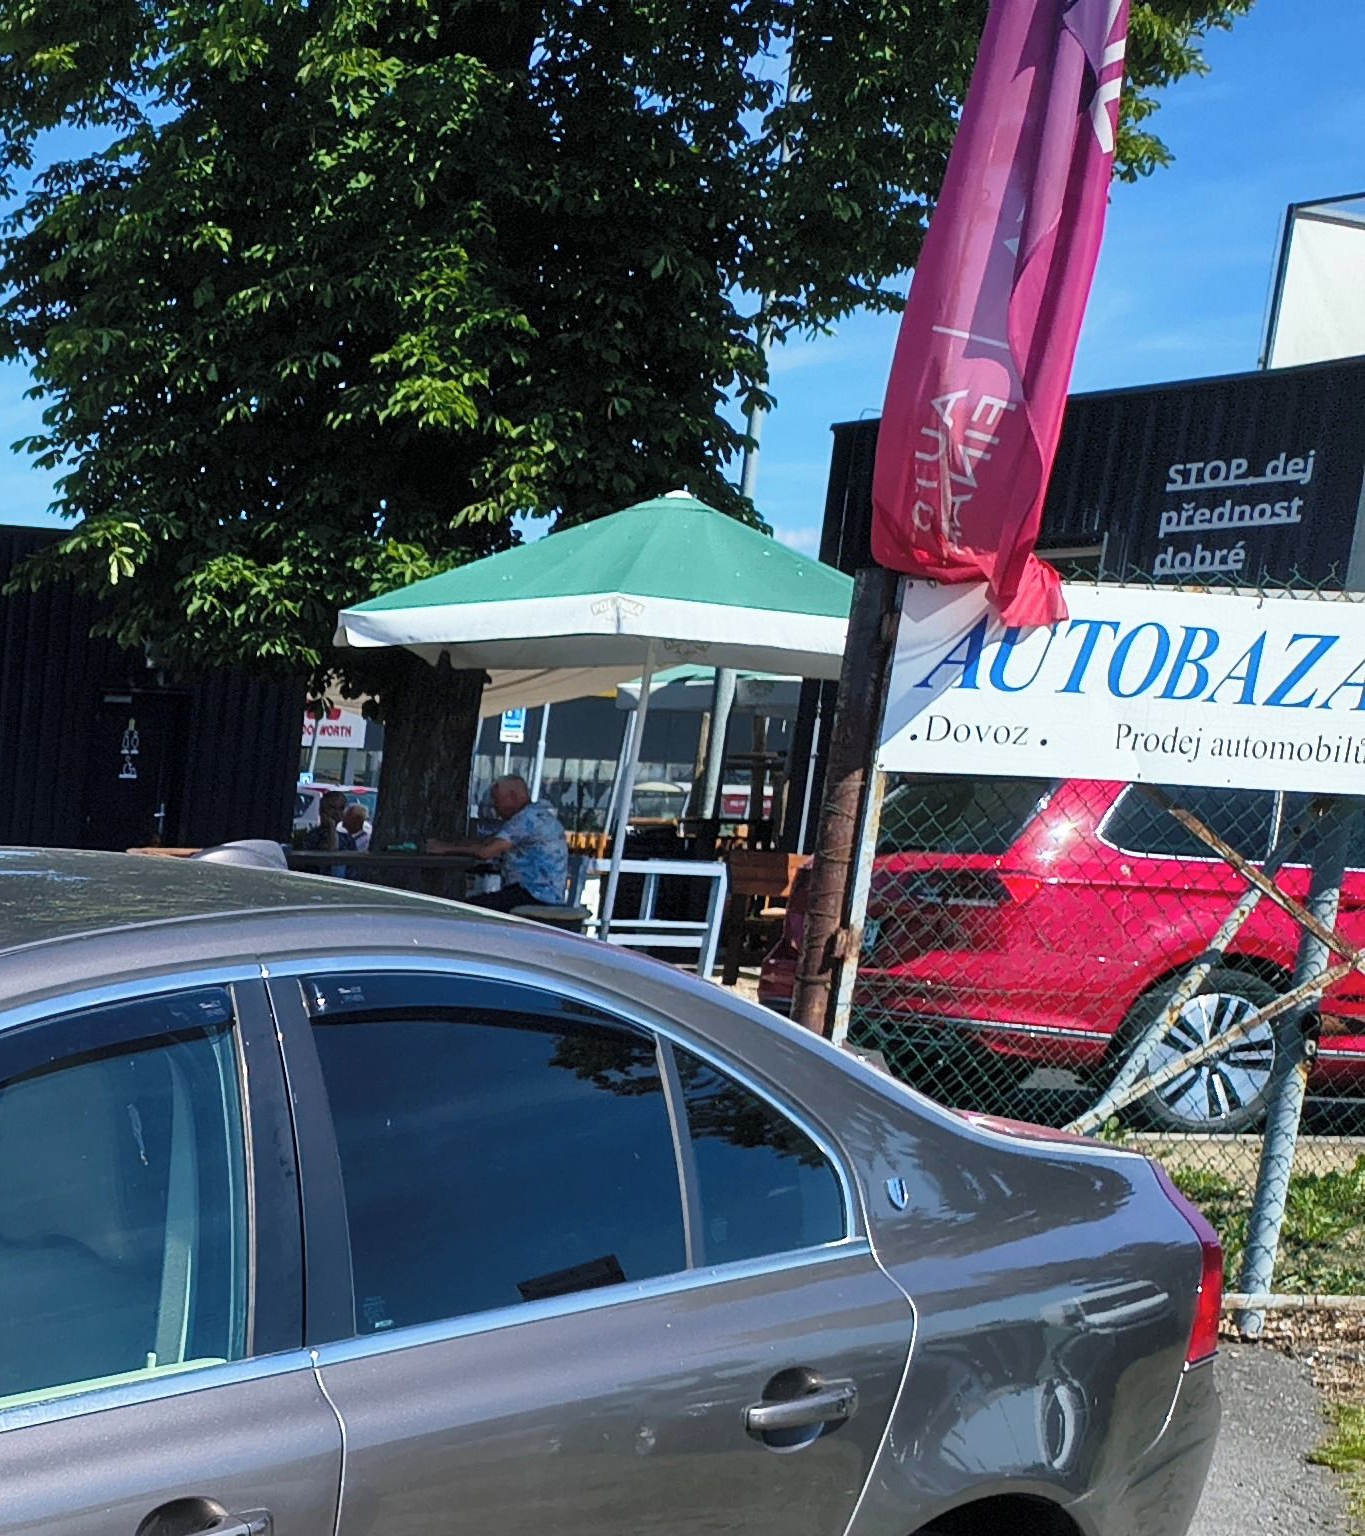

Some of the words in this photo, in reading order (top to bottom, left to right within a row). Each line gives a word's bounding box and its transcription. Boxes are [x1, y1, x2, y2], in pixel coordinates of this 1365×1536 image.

[1265, 450, 1316, 485] dej
[1158, 496, 1304, 539] přednost
[1153, 541, 1246, 575] dobré
[913, 612, 1365, 712] AUTOBAZA
[1115, 723, 1204, 764] Prodej
